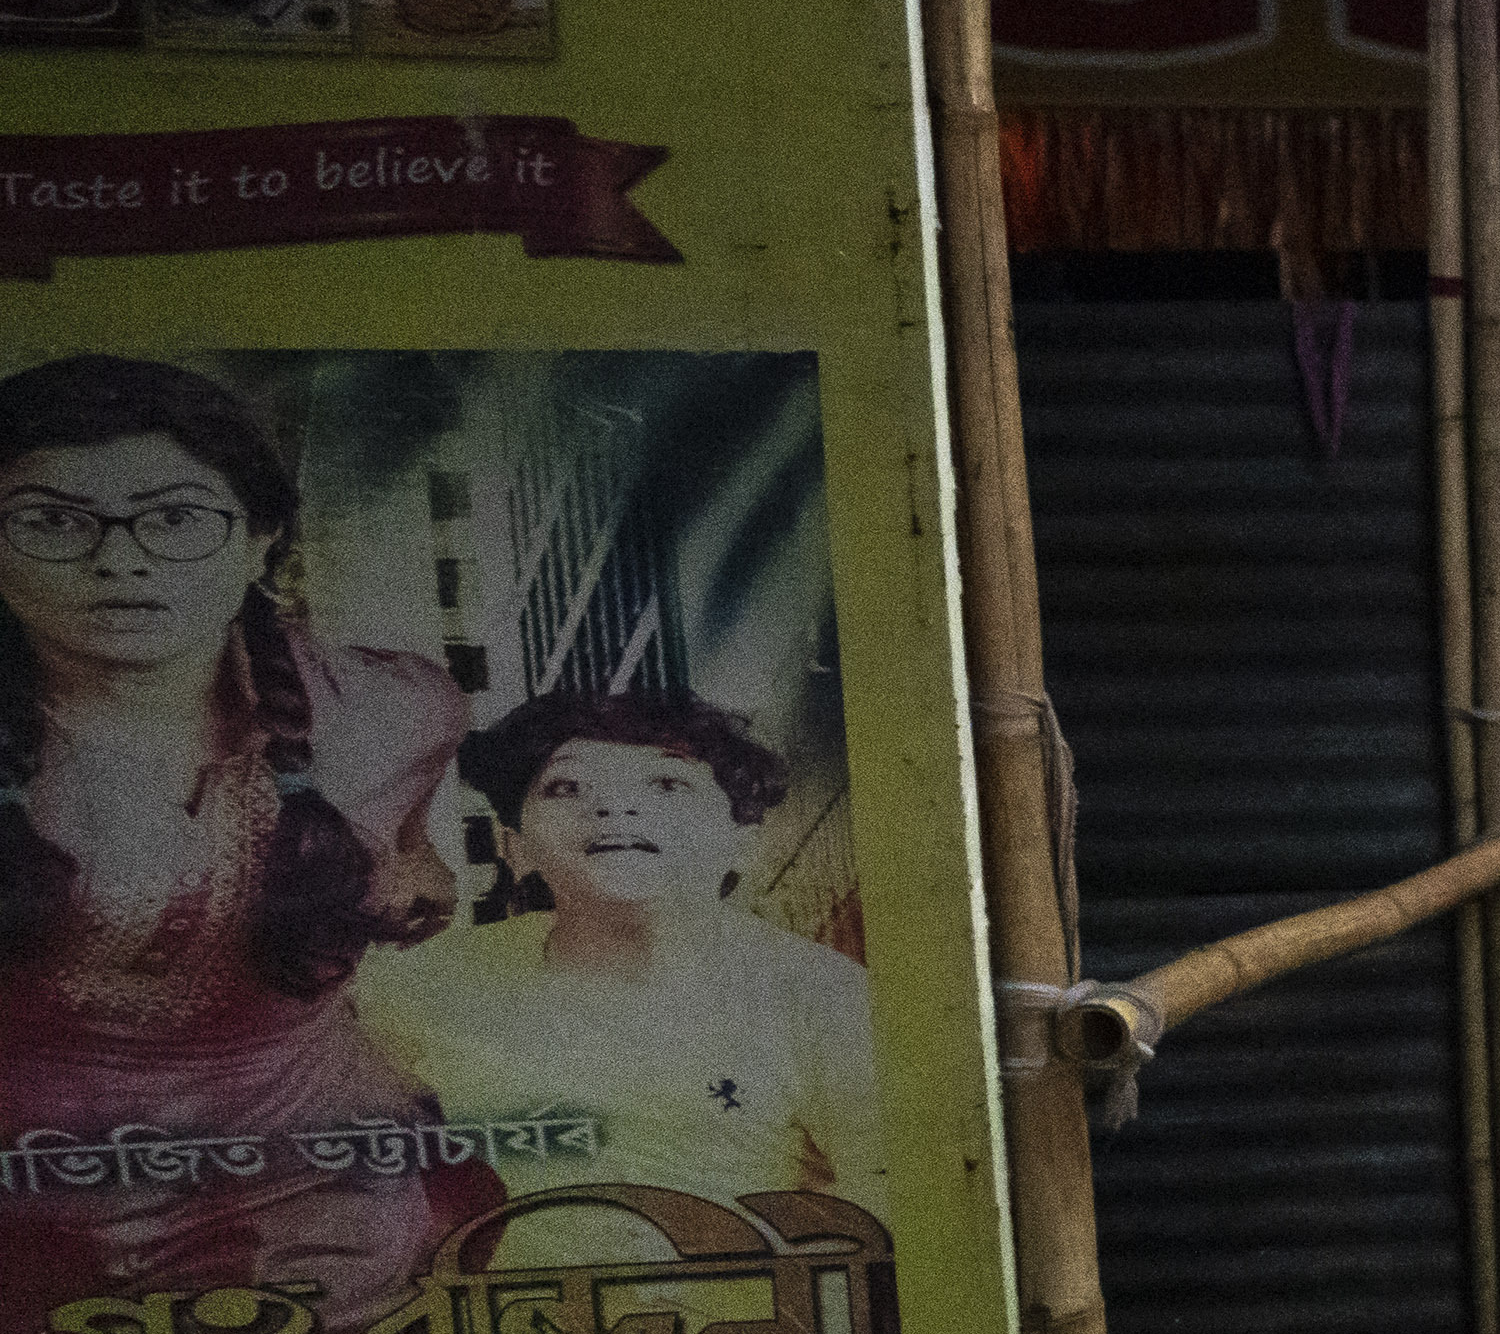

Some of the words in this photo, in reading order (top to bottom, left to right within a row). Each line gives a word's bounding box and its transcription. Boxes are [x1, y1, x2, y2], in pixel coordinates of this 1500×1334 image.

[0, 171, 143, 210] Taste
[168, 166, 212, 207] it
[231, 164, 290, 201] to
[314, 149, 492, 193] believe
[514, 147, 557, 187] it
